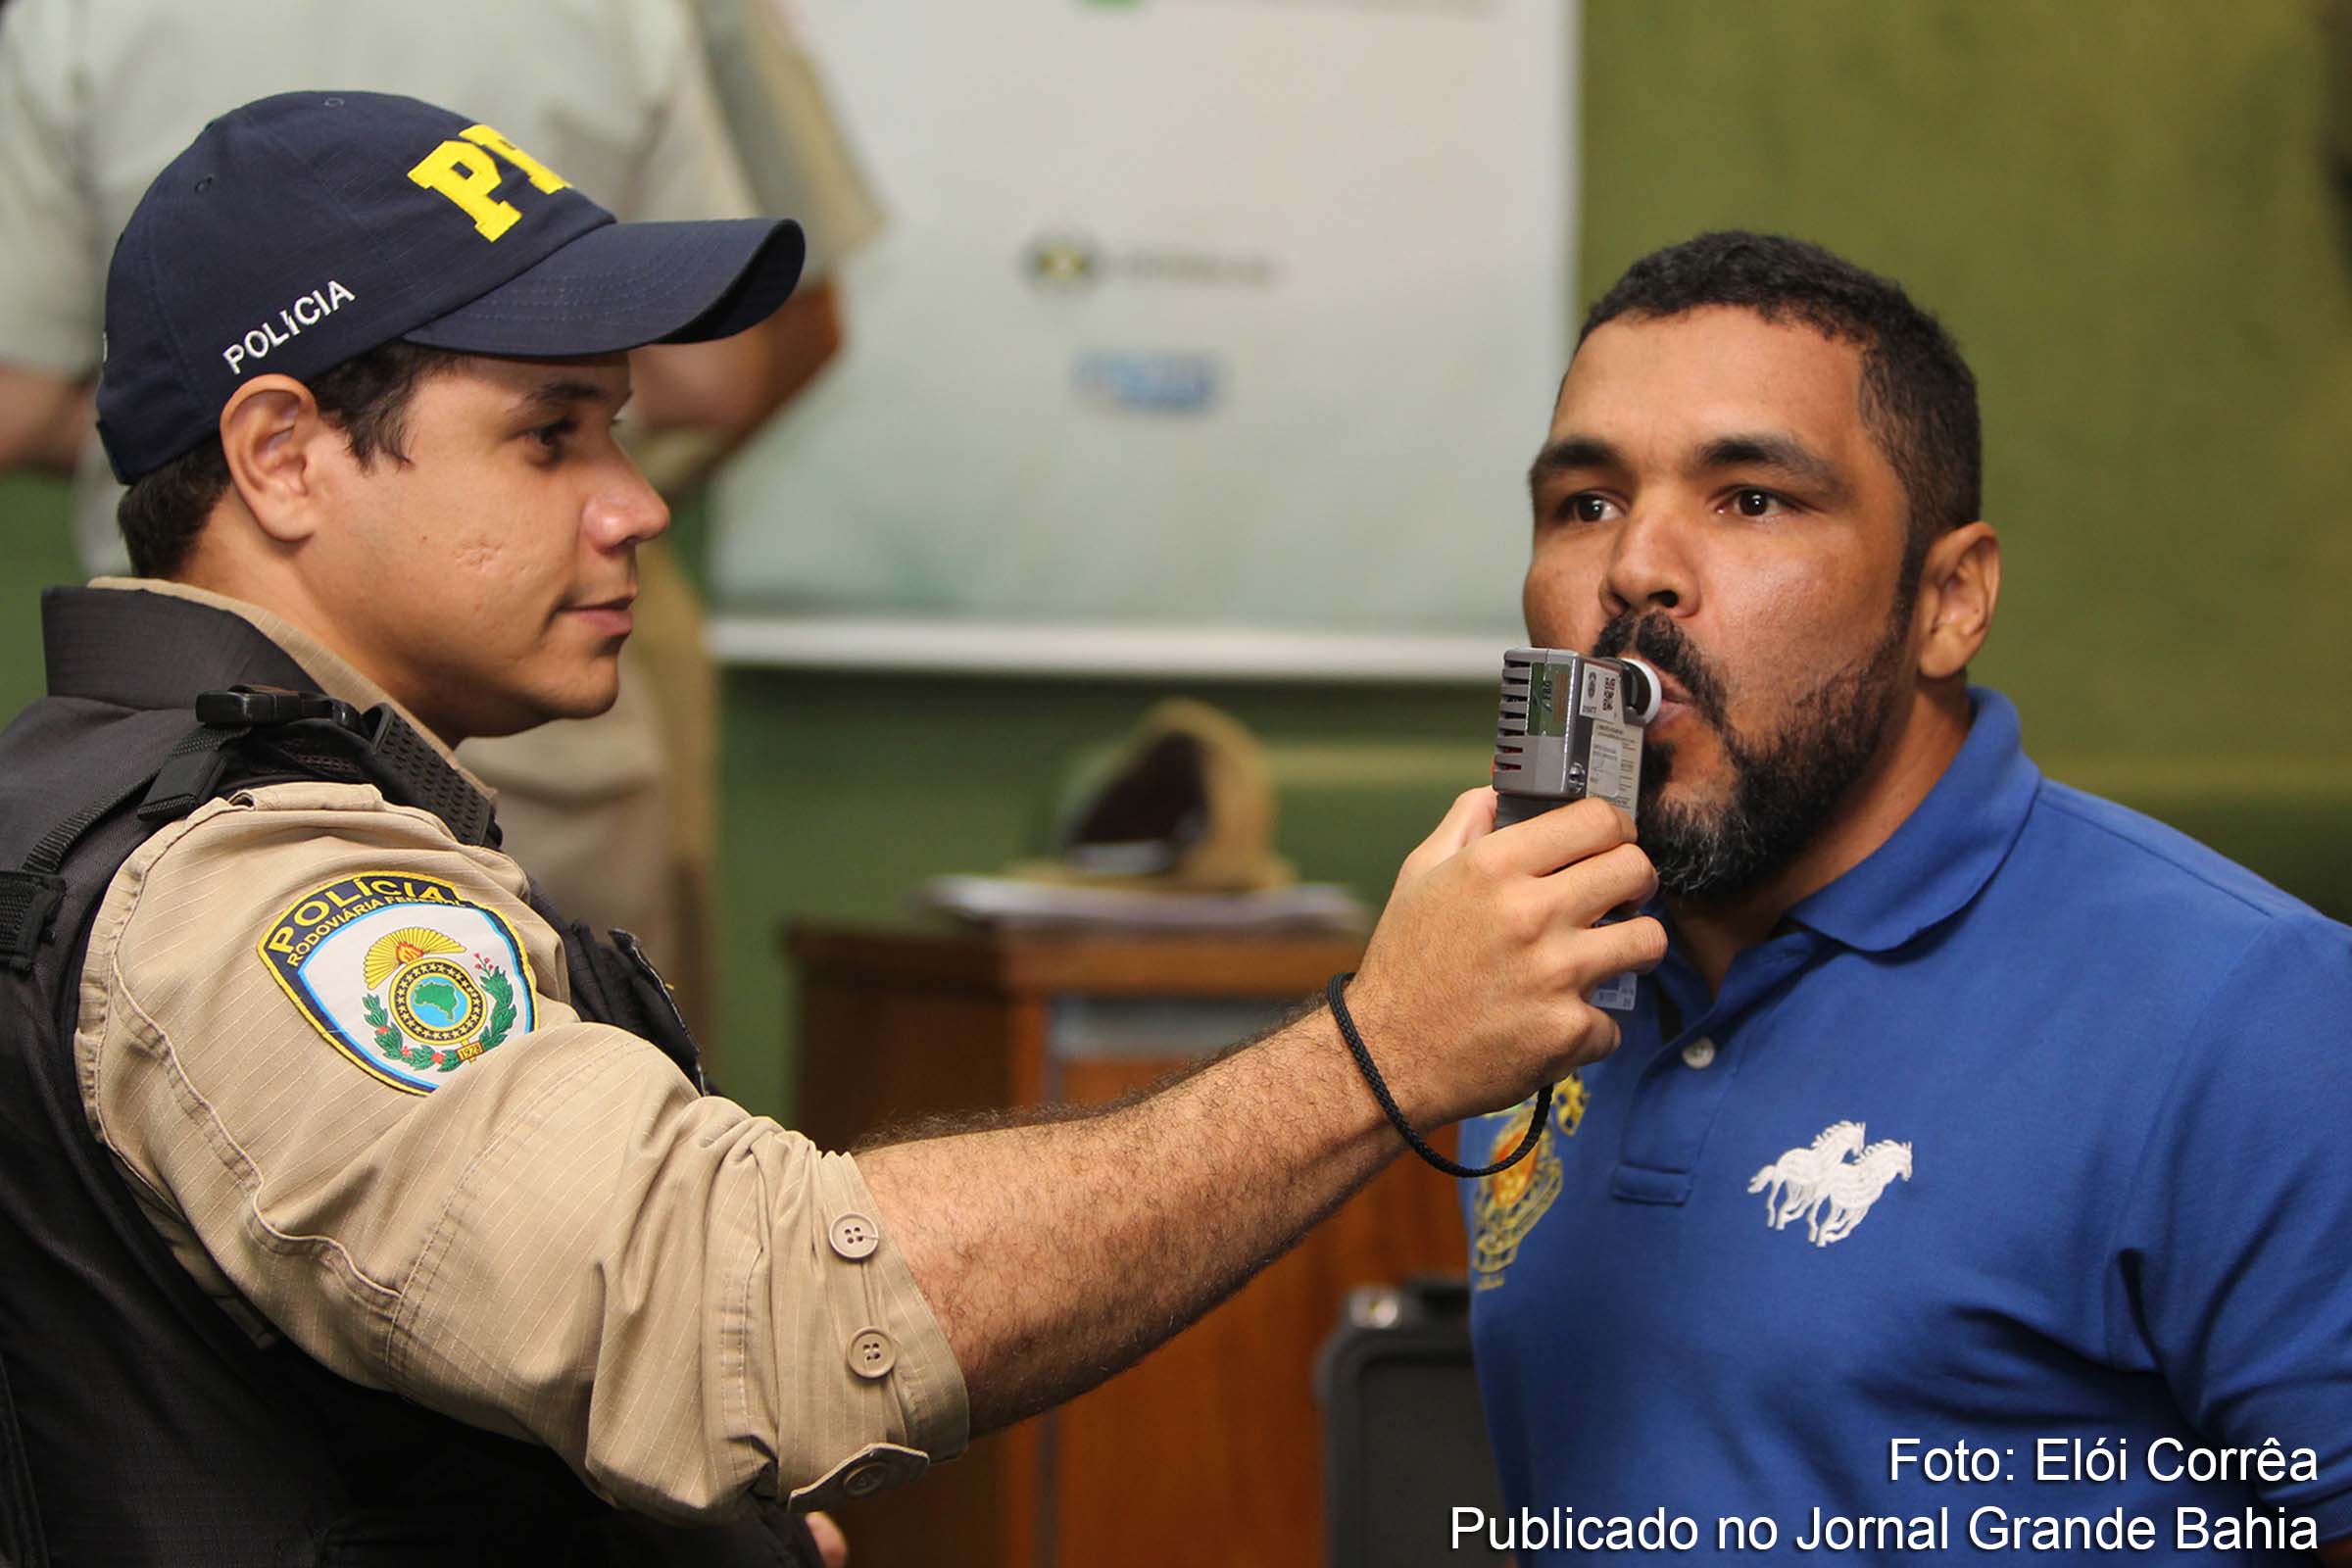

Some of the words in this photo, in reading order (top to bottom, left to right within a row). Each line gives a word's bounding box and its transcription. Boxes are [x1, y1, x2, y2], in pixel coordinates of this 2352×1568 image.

[222, 280, 356, 373] POLÍCIA
[269, 876, 447, 954] POLÍCIA
[287, 898, 385, 967] RODOVIÁRIA
